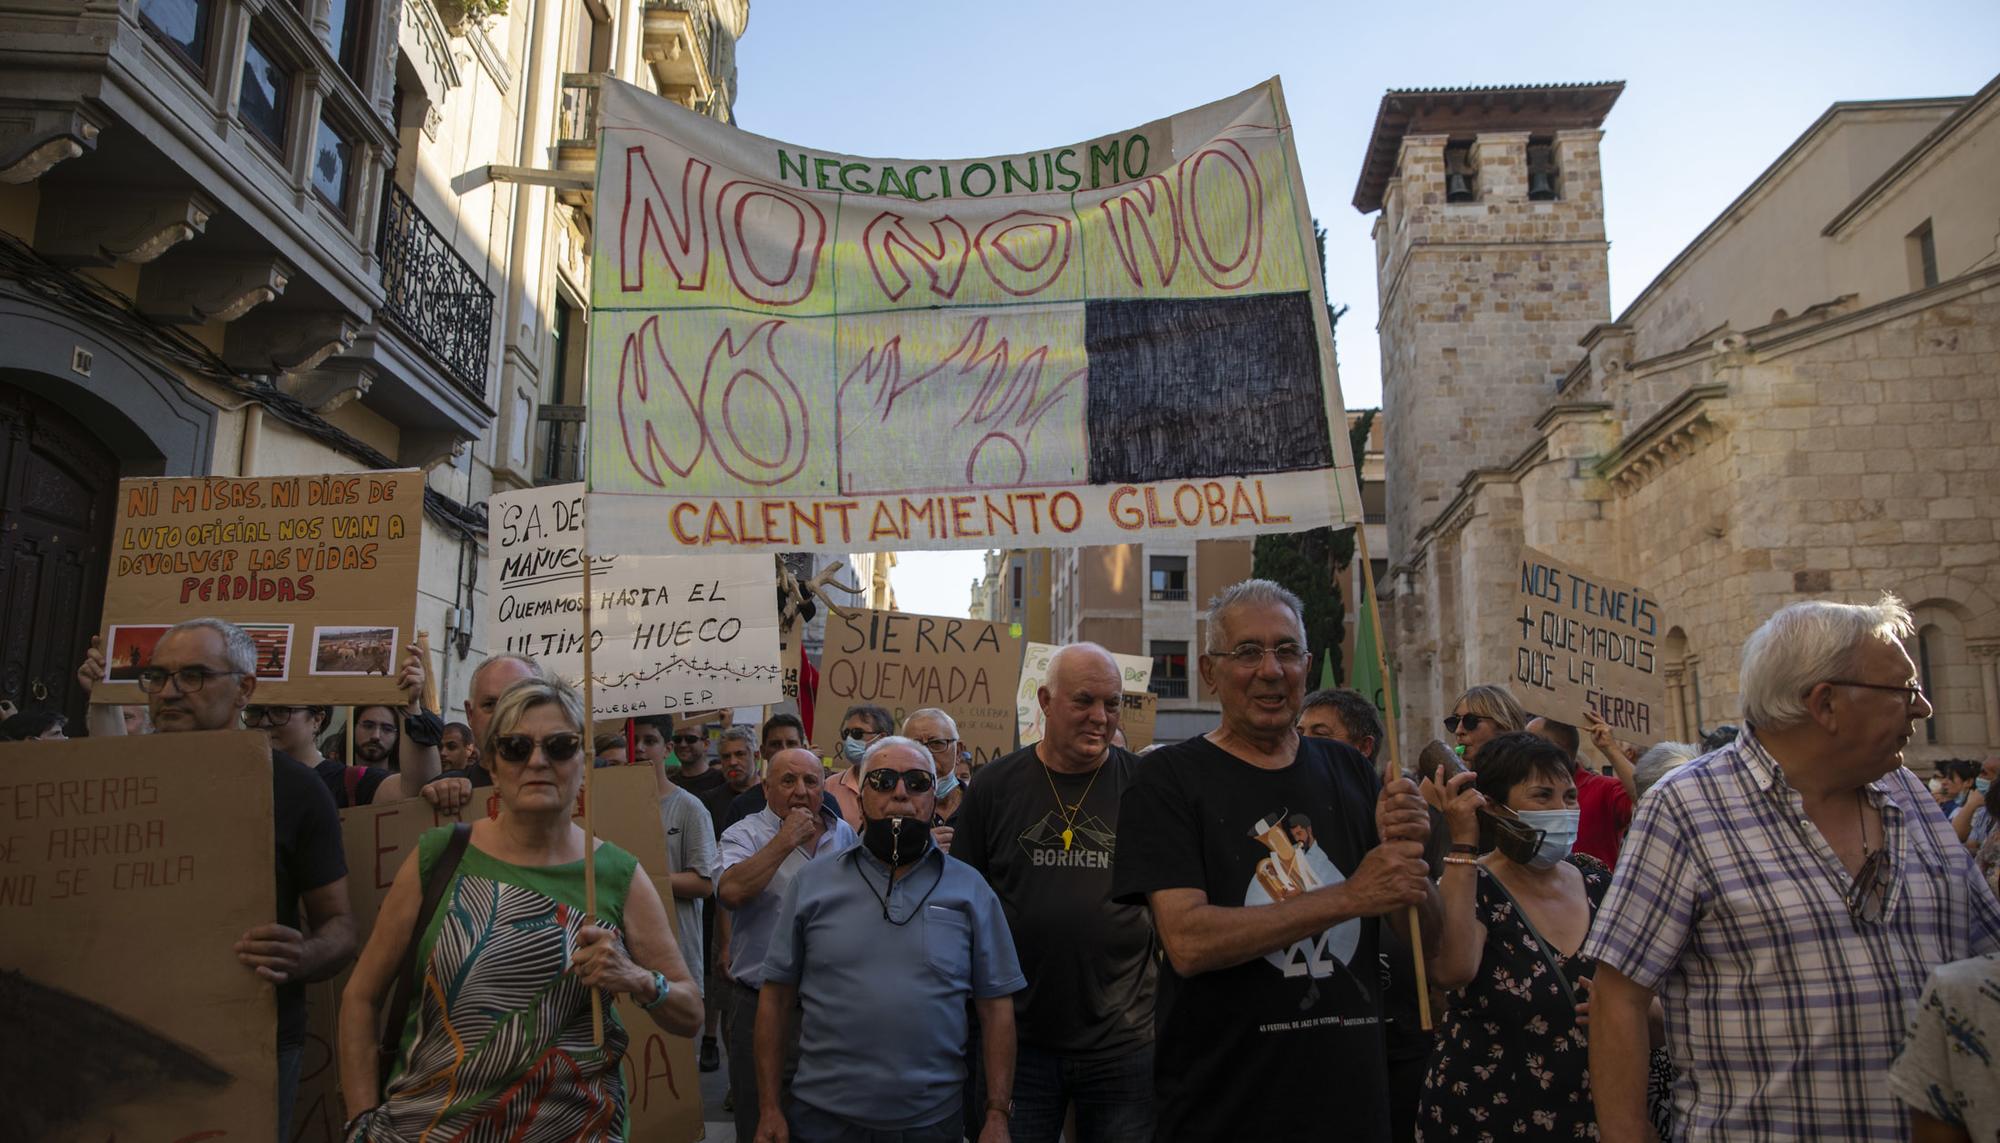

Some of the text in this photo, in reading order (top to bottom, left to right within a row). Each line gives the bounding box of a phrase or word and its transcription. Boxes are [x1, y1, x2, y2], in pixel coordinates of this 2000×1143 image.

[776, 134, 1151, 201] NEGACIONISMO
[620, 137, 1264, 306] NO NO NO
[617, 313, 811, 488] NO
[128, 481, 159, 517] NI
[272, 479, 299, 508] NI
[369, 480, 398, 502] DE
[669, 480, 1292, 548] CALENTAMIENTO GLOBAL
[122, 515, 405, 551] LUTO OFICIAL NOS VAN A
[118, 543, 379, 576] DEVOLVER LAS VIDAS
[180, 572, 315, 604] PERDIDAS
[601, 585, 669, 610] HASTA
[687, 581, 726, 602] EL
[1522, 560, 1658, 636] NOS TENEIS
[632, 617, 741, 650] HUECO
[841, 610, 1000, 654] SIERRA
[828, 659, 990, 704] QUEMADA
[1518, 647, 1595, 692] QUE LA
[1586, 687, 1649, 735] SIERRA
[48, 819, 165, 862] ARRIBA
[1033, 848, 1109, 869] BORIKEN
[0, 855, 194, 907] NO SE CALLA
